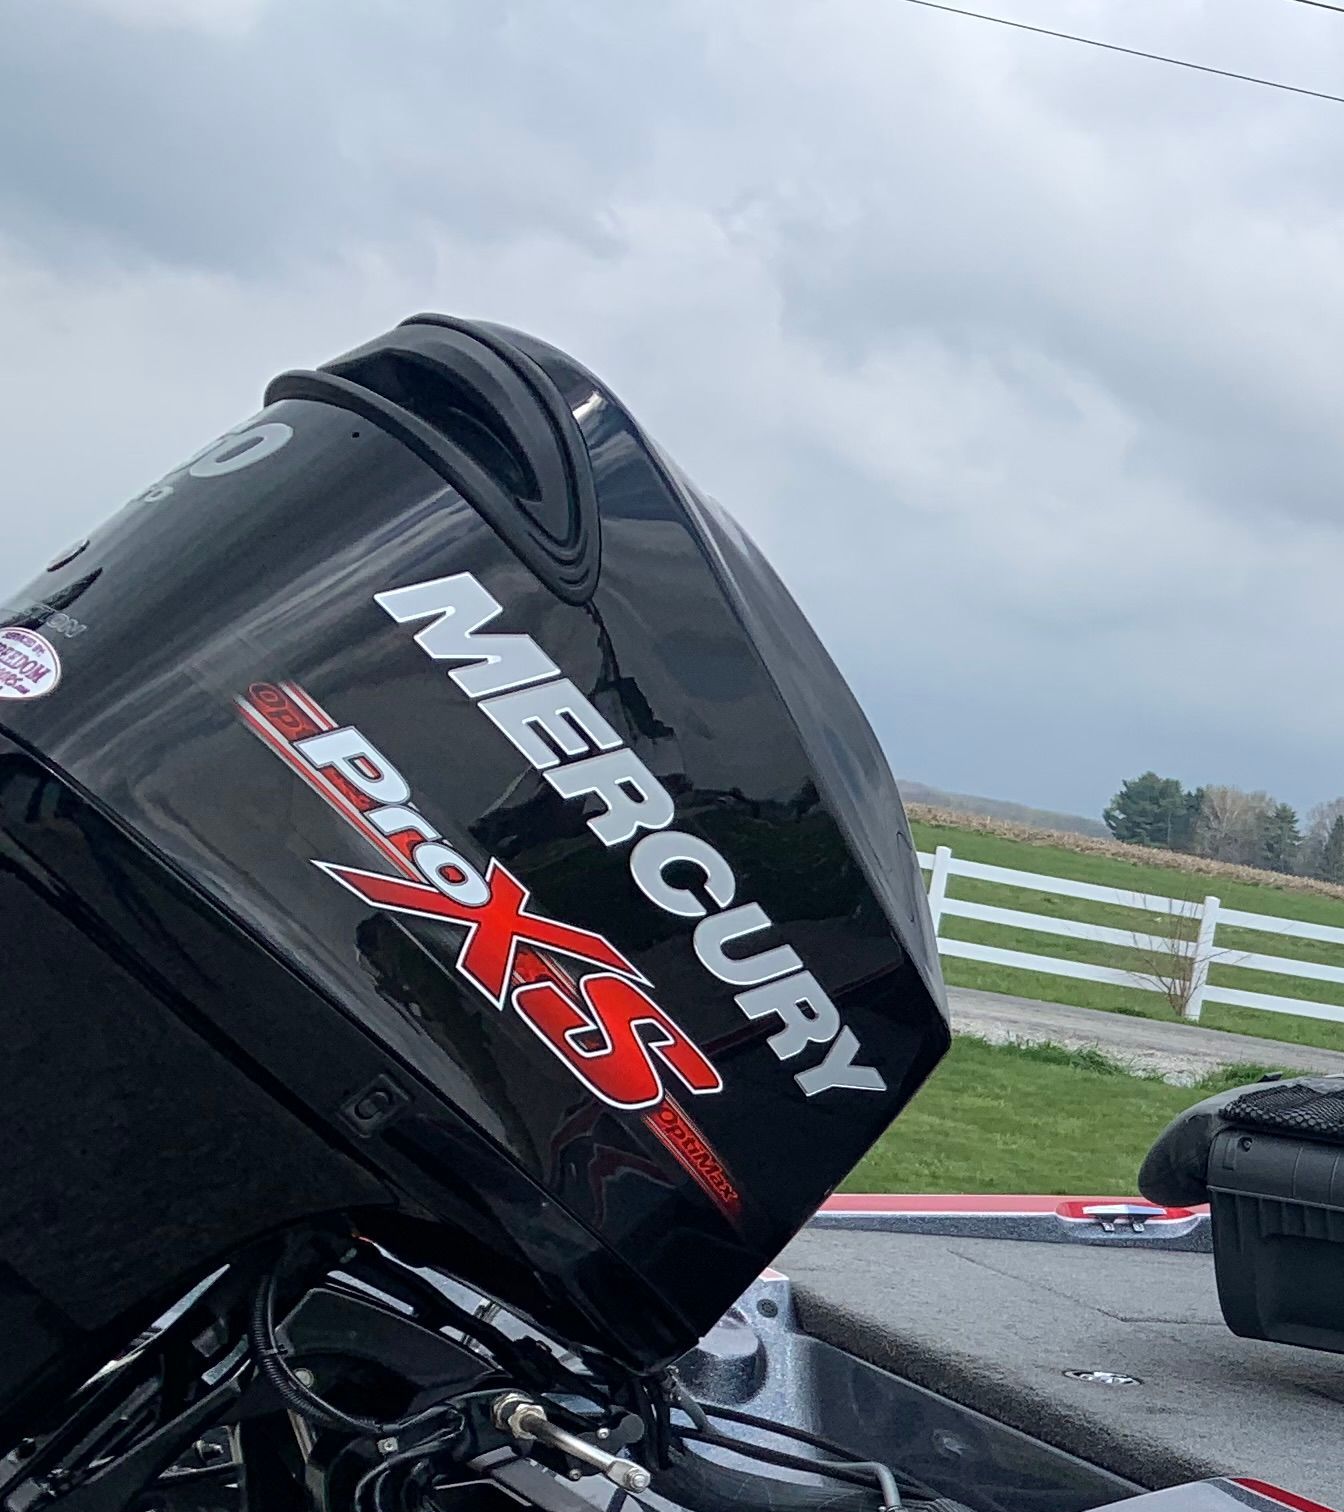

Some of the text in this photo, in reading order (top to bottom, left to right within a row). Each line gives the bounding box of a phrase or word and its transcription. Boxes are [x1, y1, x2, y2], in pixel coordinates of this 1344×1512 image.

[0, 641, 52, 683] REEDOM
[290, 725, 492, 907] Pro
[375, 571, 888, 1097] MERCURY
[310, 857, 723, 1110] XS
